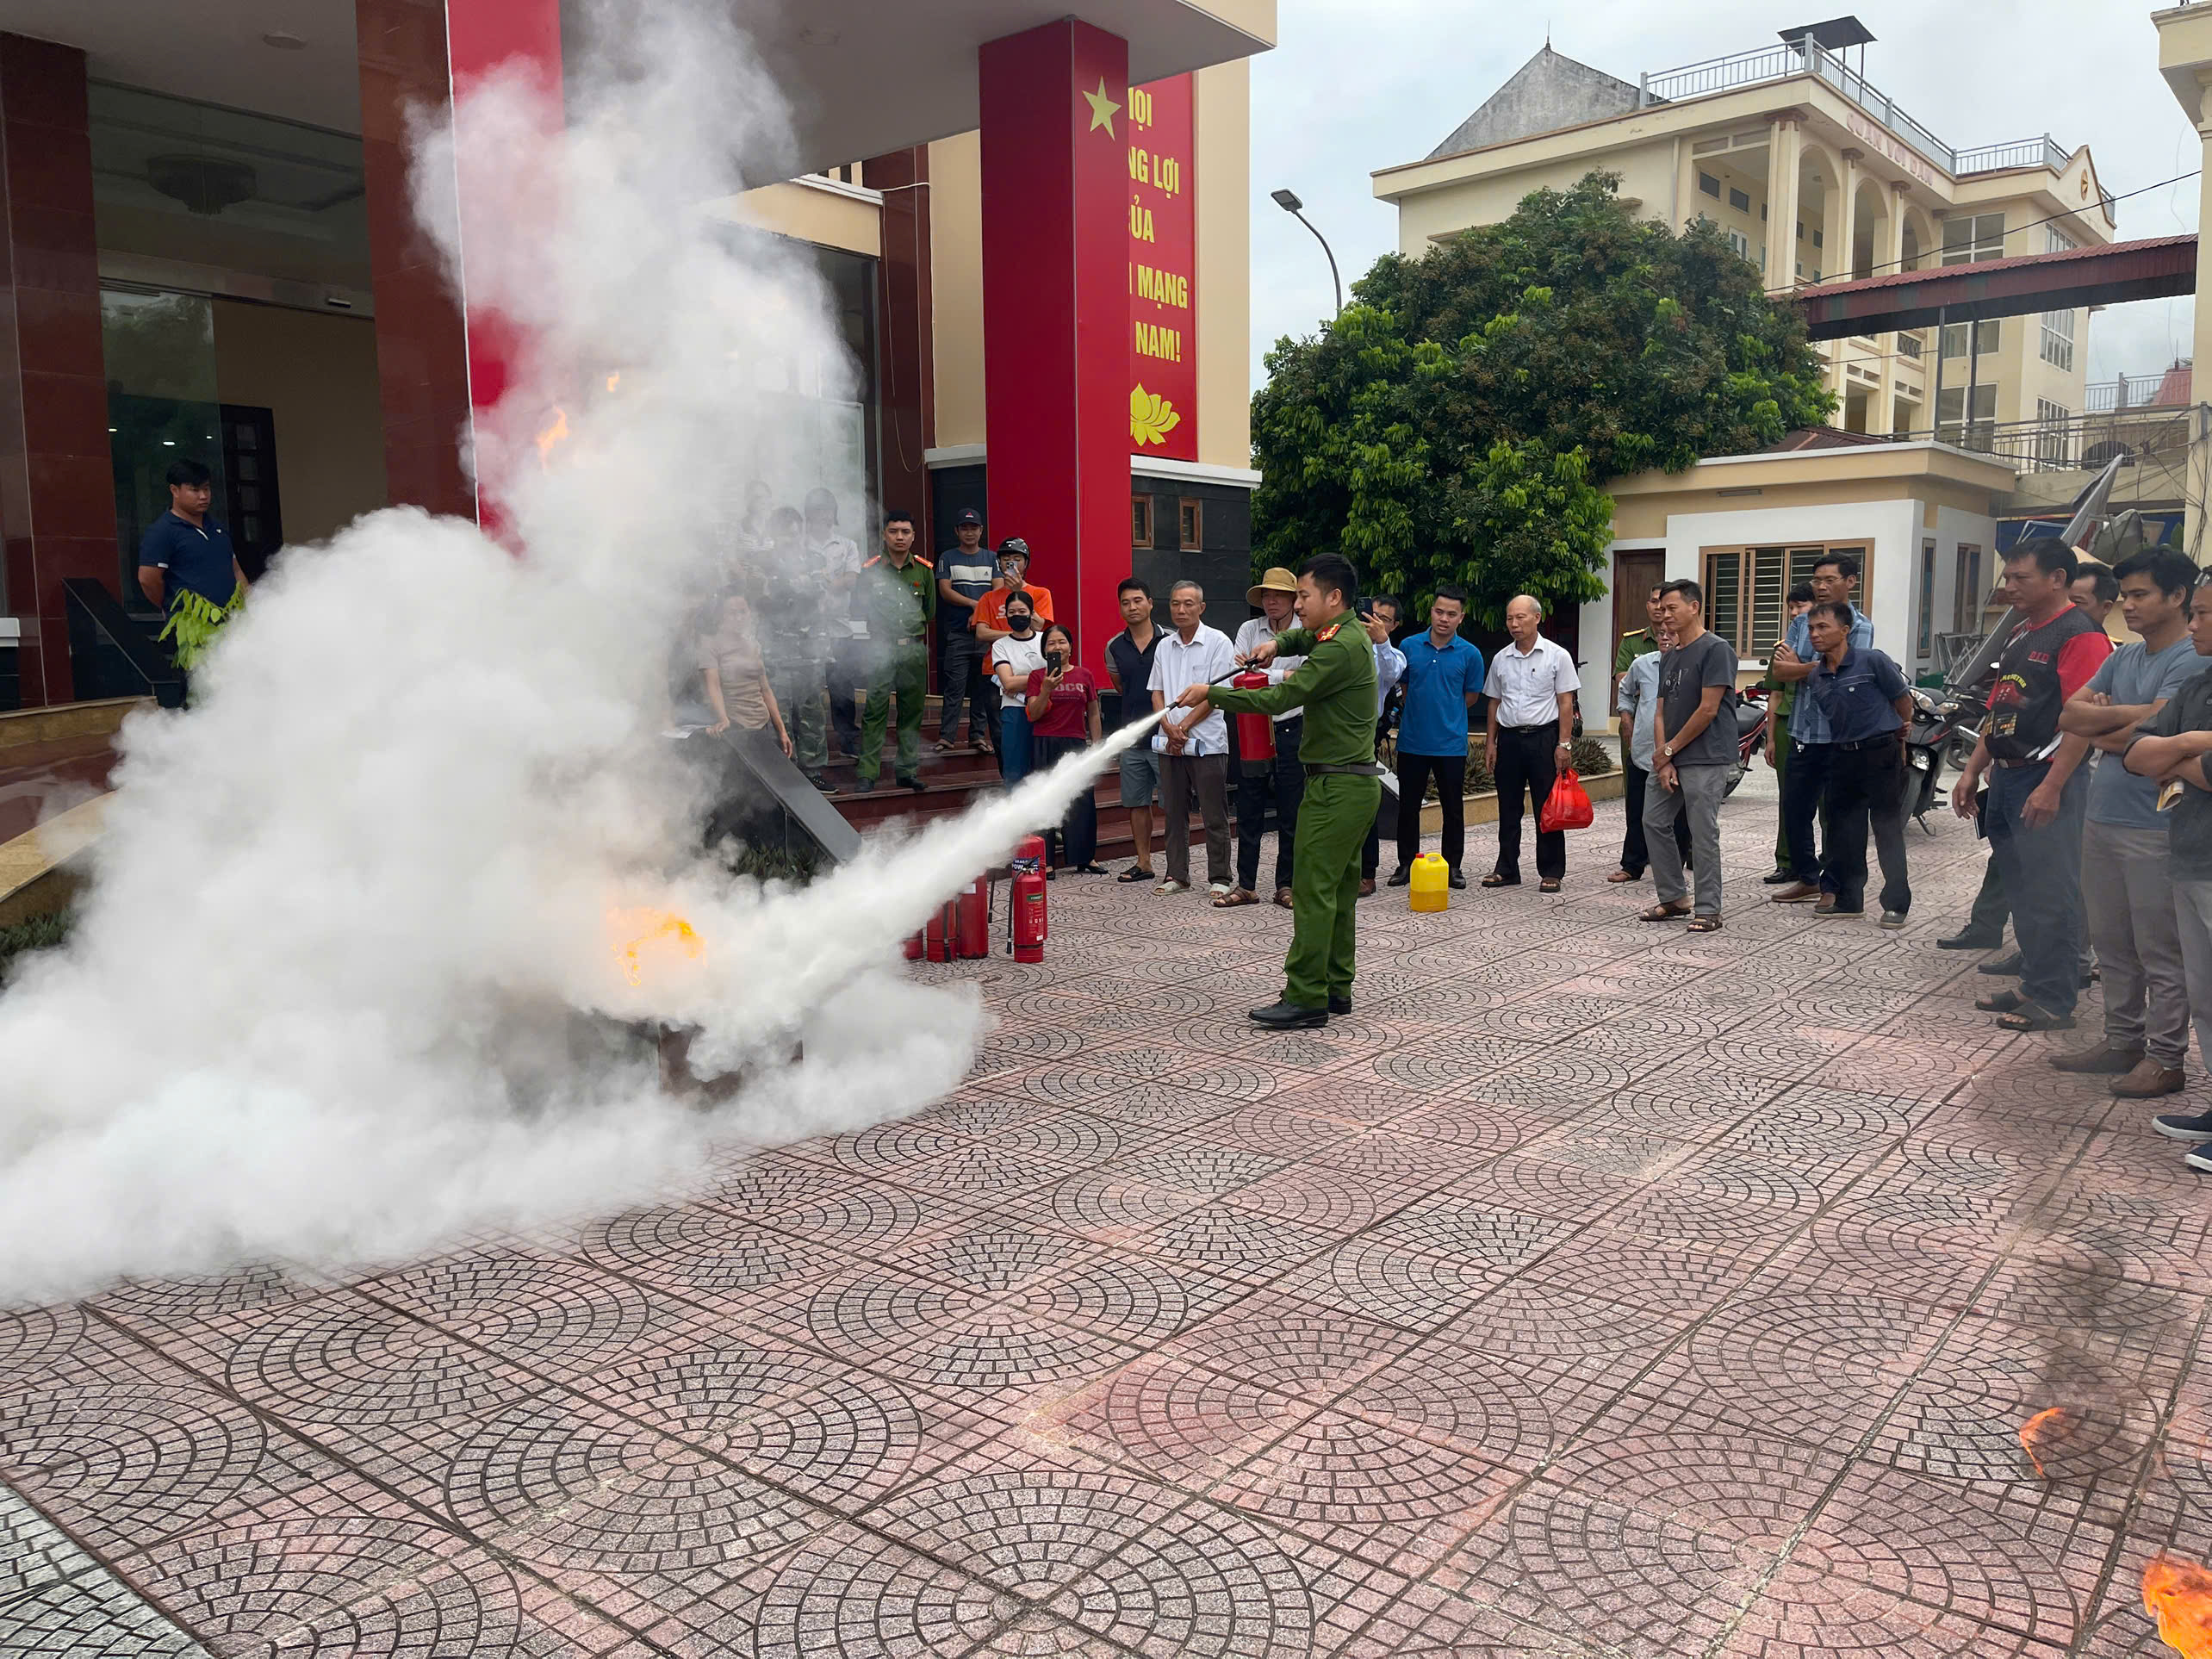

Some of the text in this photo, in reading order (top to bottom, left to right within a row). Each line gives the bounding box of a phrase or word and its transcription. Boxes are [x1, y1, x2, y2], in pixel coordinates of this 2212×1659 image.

[1128, 146, 1179, 199] NG LỢI
[1128, 194, 1155, 243] ỦA
[1137, 264, 1188, 309] MẠNG
[1135, 320, 1180, 363] NAM!
